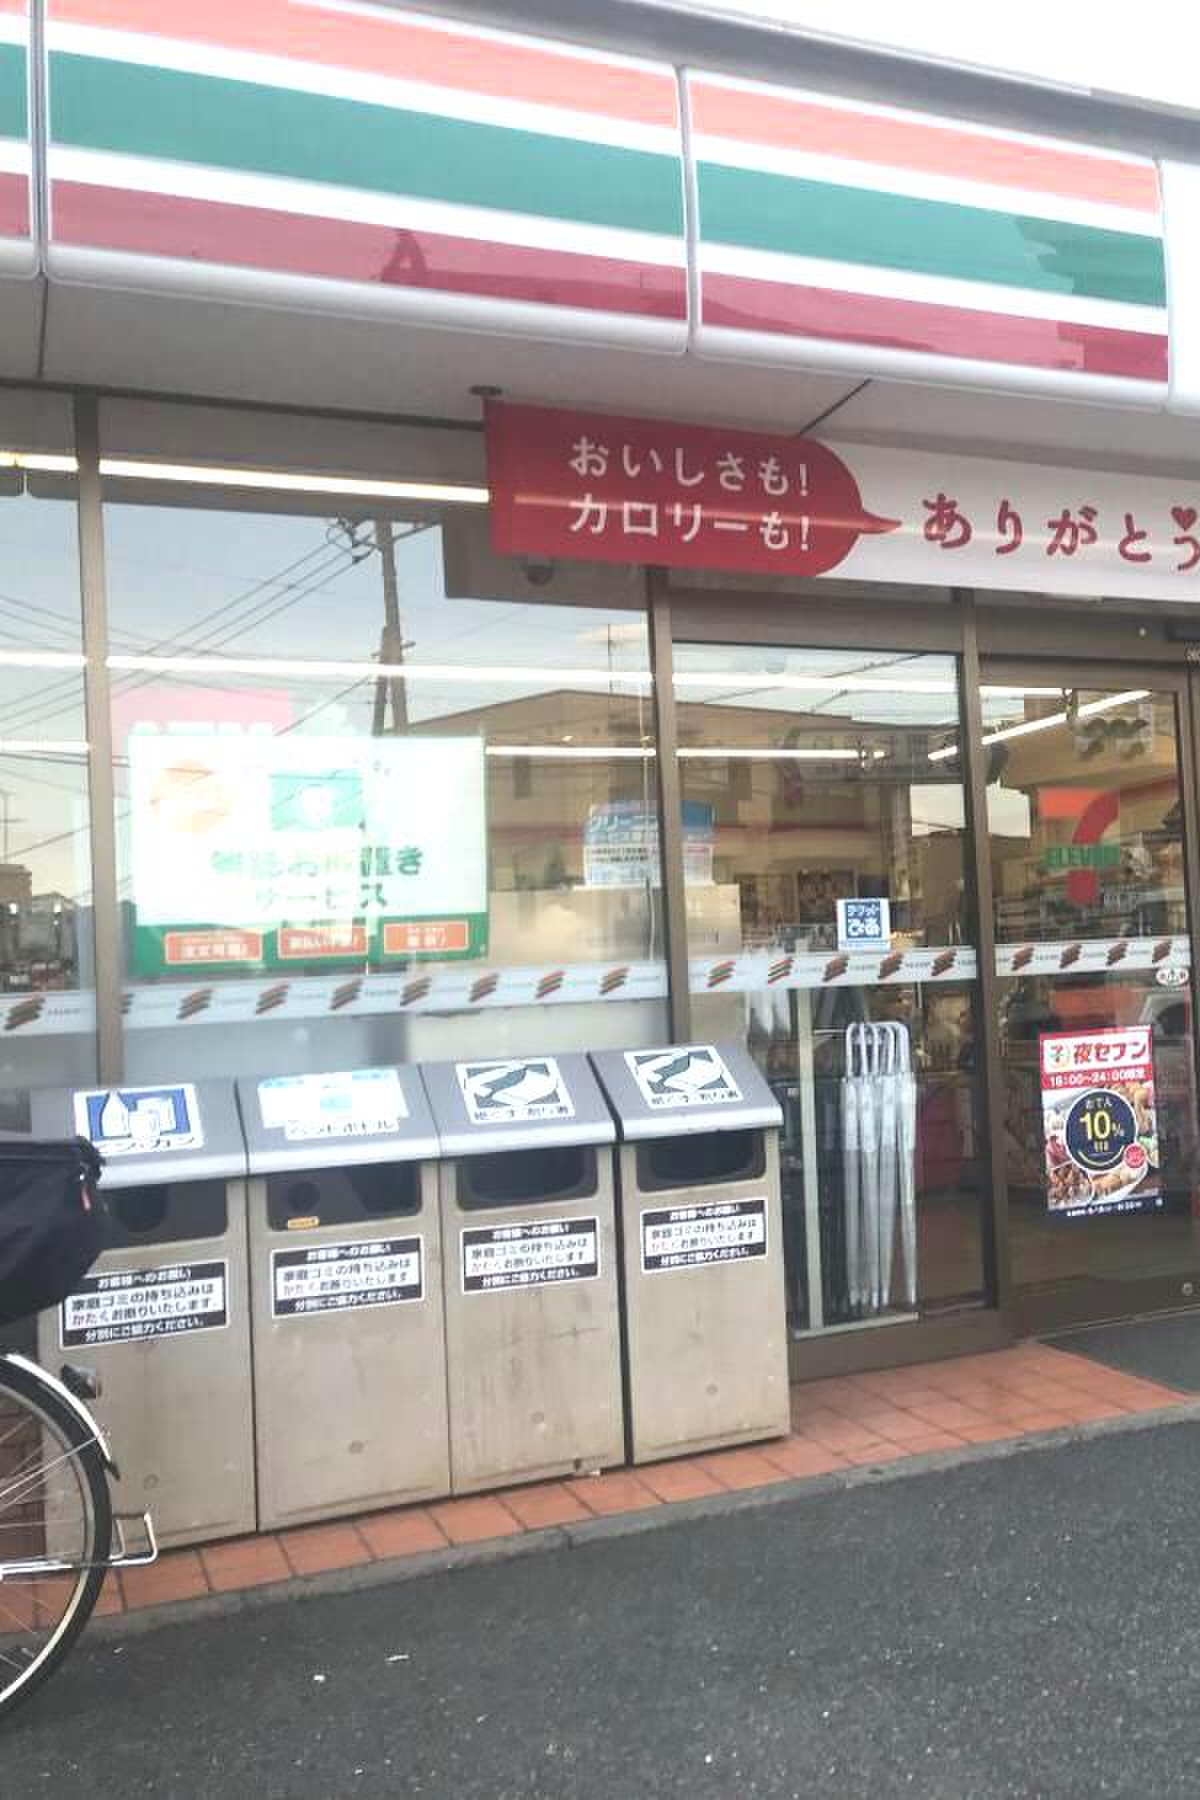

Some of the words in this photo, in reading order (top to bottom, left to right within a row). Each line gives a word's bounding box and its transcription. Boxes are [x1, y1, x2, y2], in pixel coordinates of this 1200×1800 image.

[568, 435, 810, 497] おいしさも!
[568, 491, 811, 552] カロリーも!
